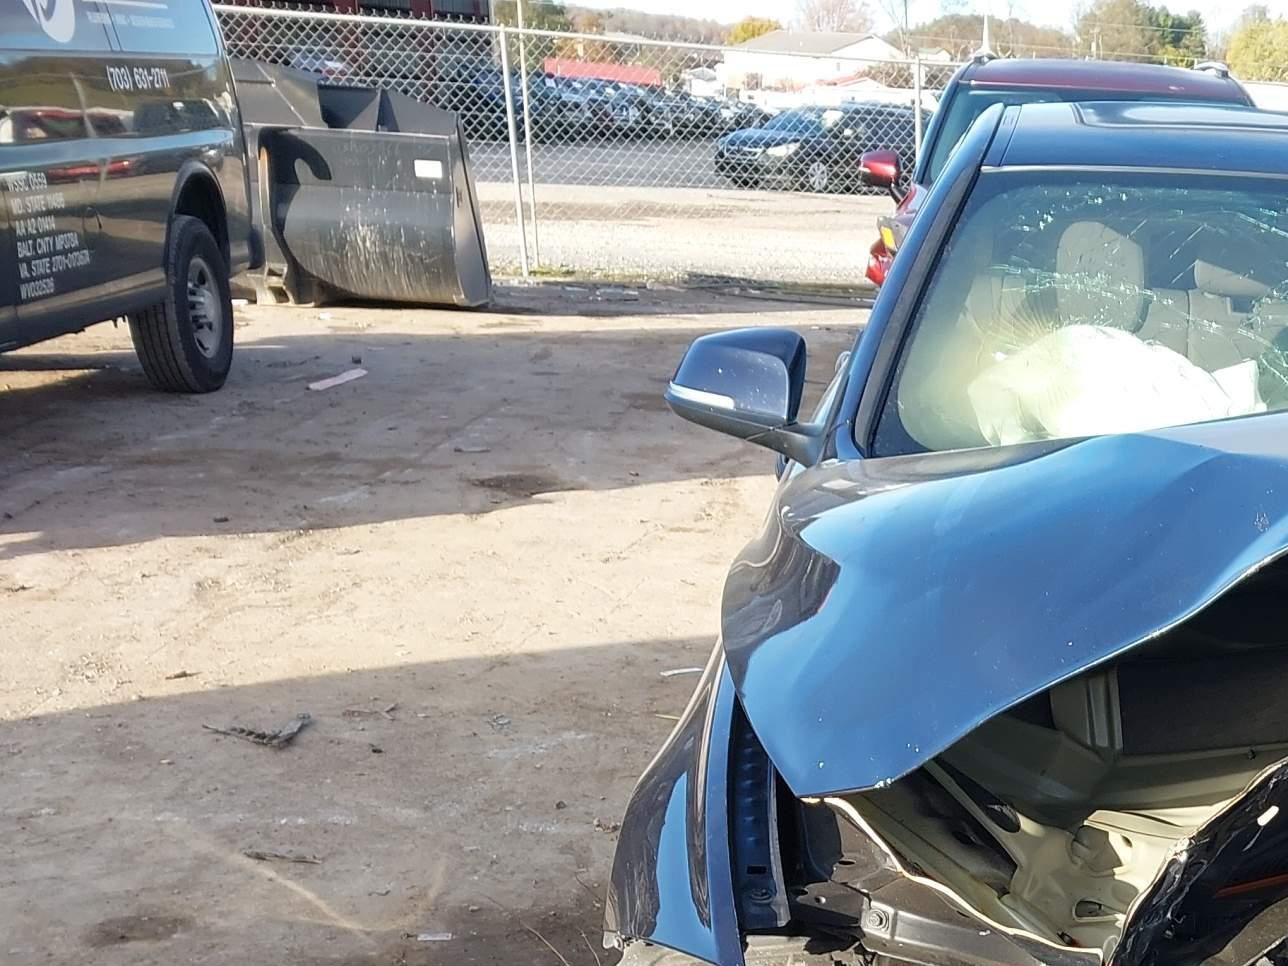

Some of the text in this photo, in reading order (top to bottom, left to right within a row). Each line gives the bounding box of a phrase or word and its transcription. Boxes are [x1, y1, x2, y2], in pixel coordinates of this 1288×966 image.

[106, 65, 170, 92] (703) 631-2711
[25, 195, 46, 213] STATE
[17, 240, 35, 258] BALT.
[36, 236, 54, 255] CNTY
[31, 257, 51, 276] STATE
